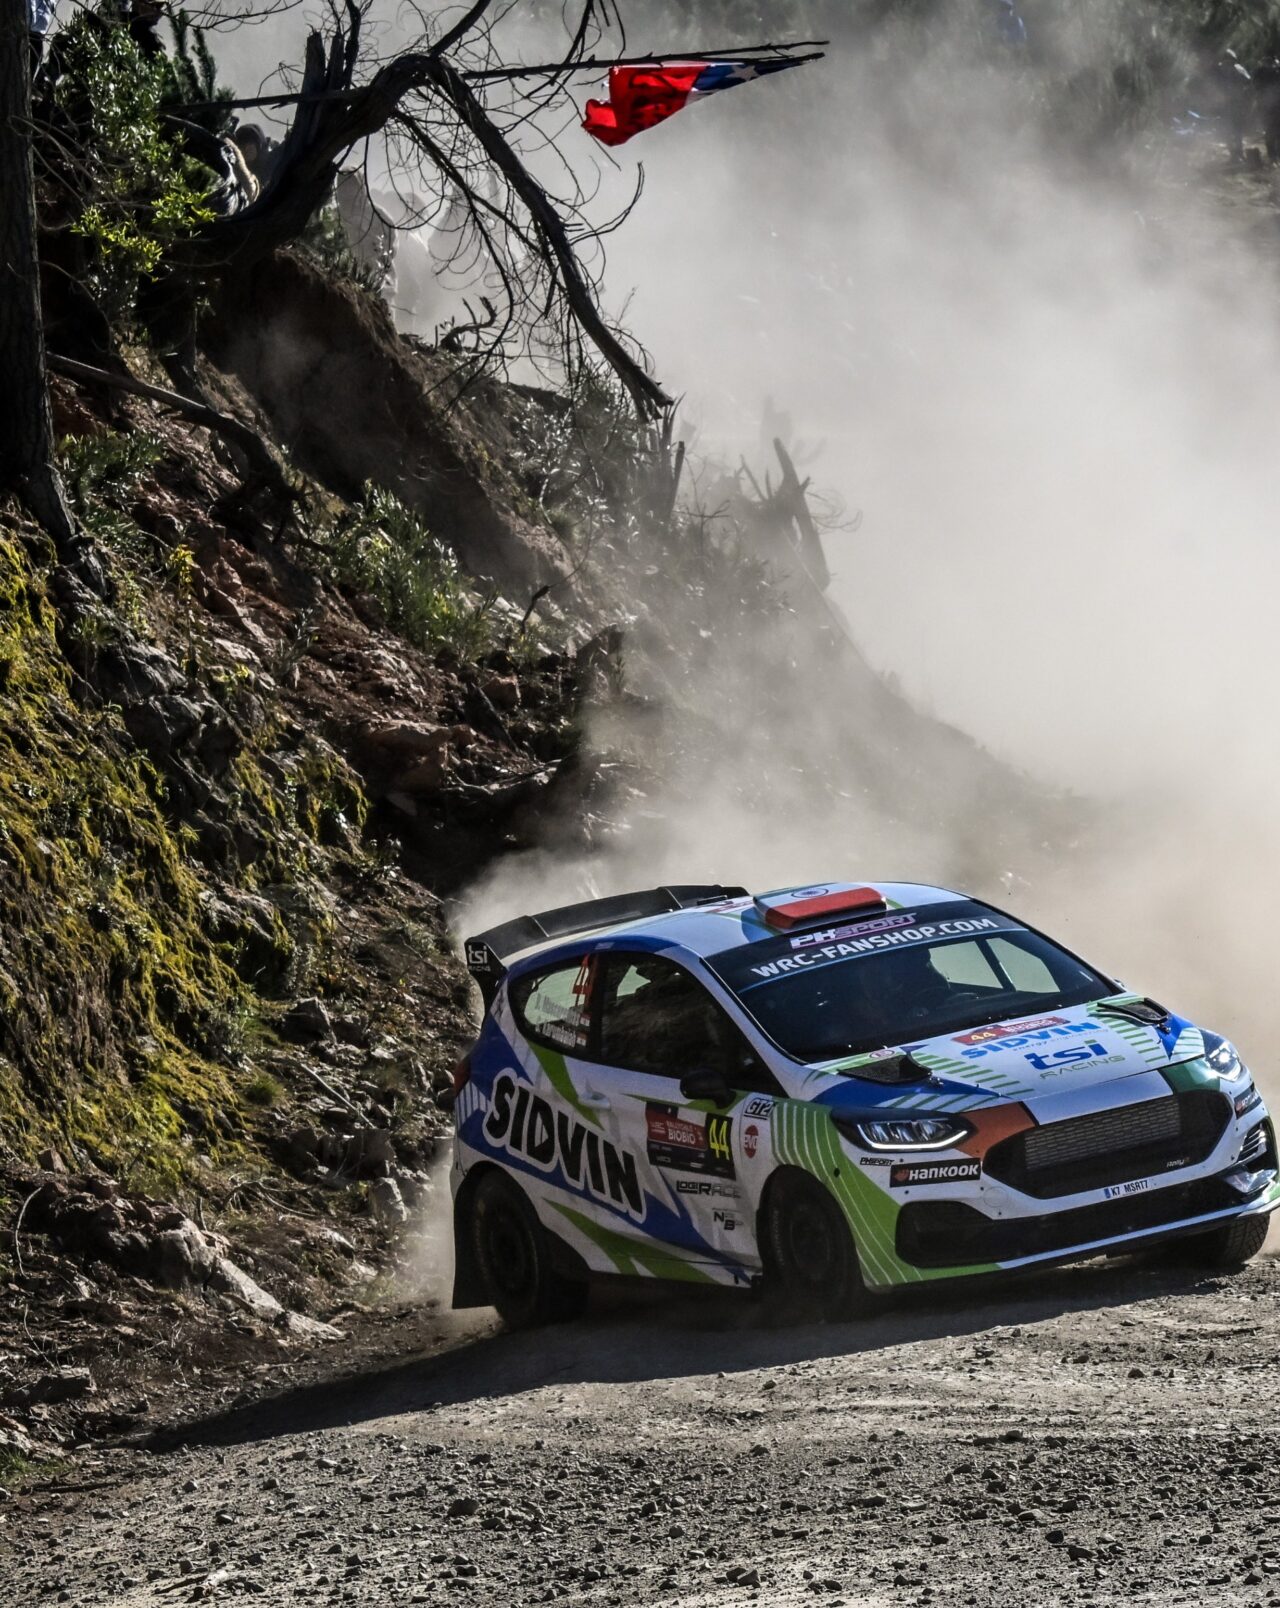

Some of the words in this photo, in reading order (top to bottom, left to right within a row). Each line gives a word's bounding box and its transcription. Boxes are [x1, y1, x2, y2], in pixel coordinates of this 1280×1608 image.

[468, 944, 488, 964] tsi
[750, 918, 998, 977] WRC-FANSHOP.COM
[961, 1022, 1102, 1059] SIDVIN
[970, 1031, 997, 1041] 44
[1024, 1039, 1109, 1070] tsi
[1040, 1055, 1127, 1080] RACING
[485, 1075, 644, 1215] SIDVIN
[709, 1118, 730, 1160] 44
